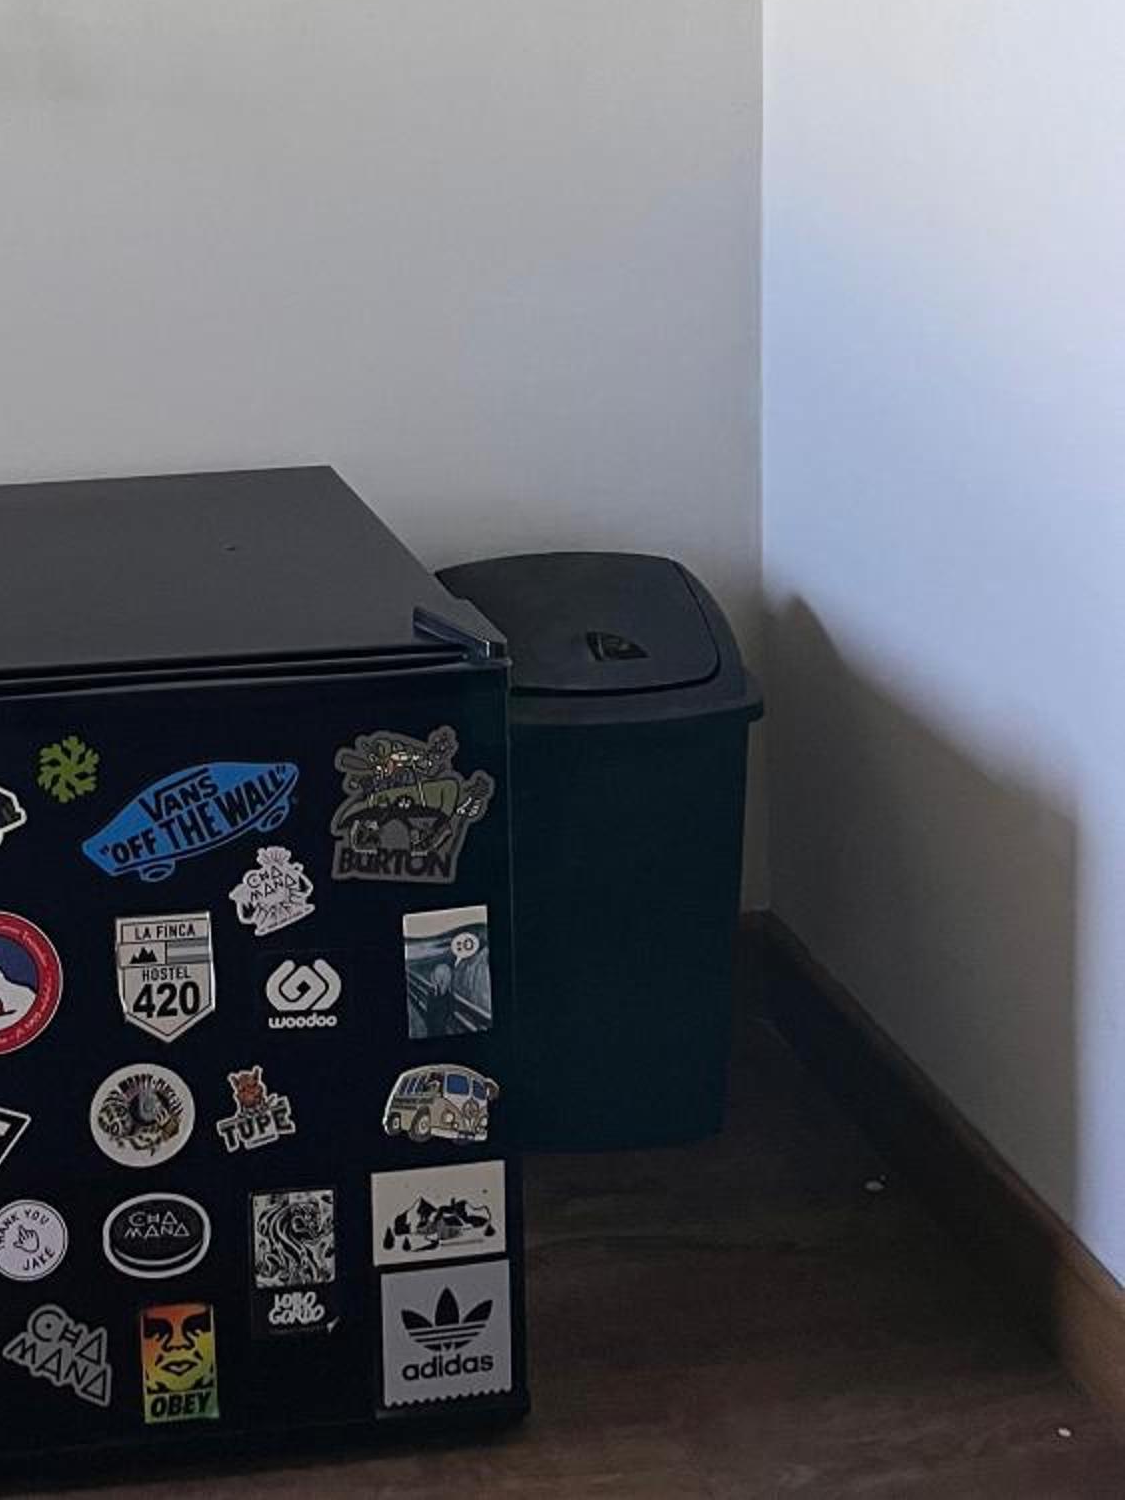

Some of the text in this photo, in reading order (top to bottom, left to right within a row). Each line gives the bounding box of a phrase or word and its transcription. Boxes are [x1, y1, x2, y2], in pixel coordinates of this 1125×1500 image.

[139, 767, 219, 823] VANS
[157, 802, 223, 850] THE
[339, 848, 452, 878] BURTON
[134, 923, 196, 941] LA FINCA
[142, 966, 192, 982] HOSTEL
[132, 981, 200, 1018] 420
[268, 1013, 338, 1029] woodoo
[24, 1208, 50, 1226] YOU
[22, 1247, 56, 1272] JAKE
[402, 1353, 494, 1381] adidas
[150, 1391, 212, 1418] OBEY
